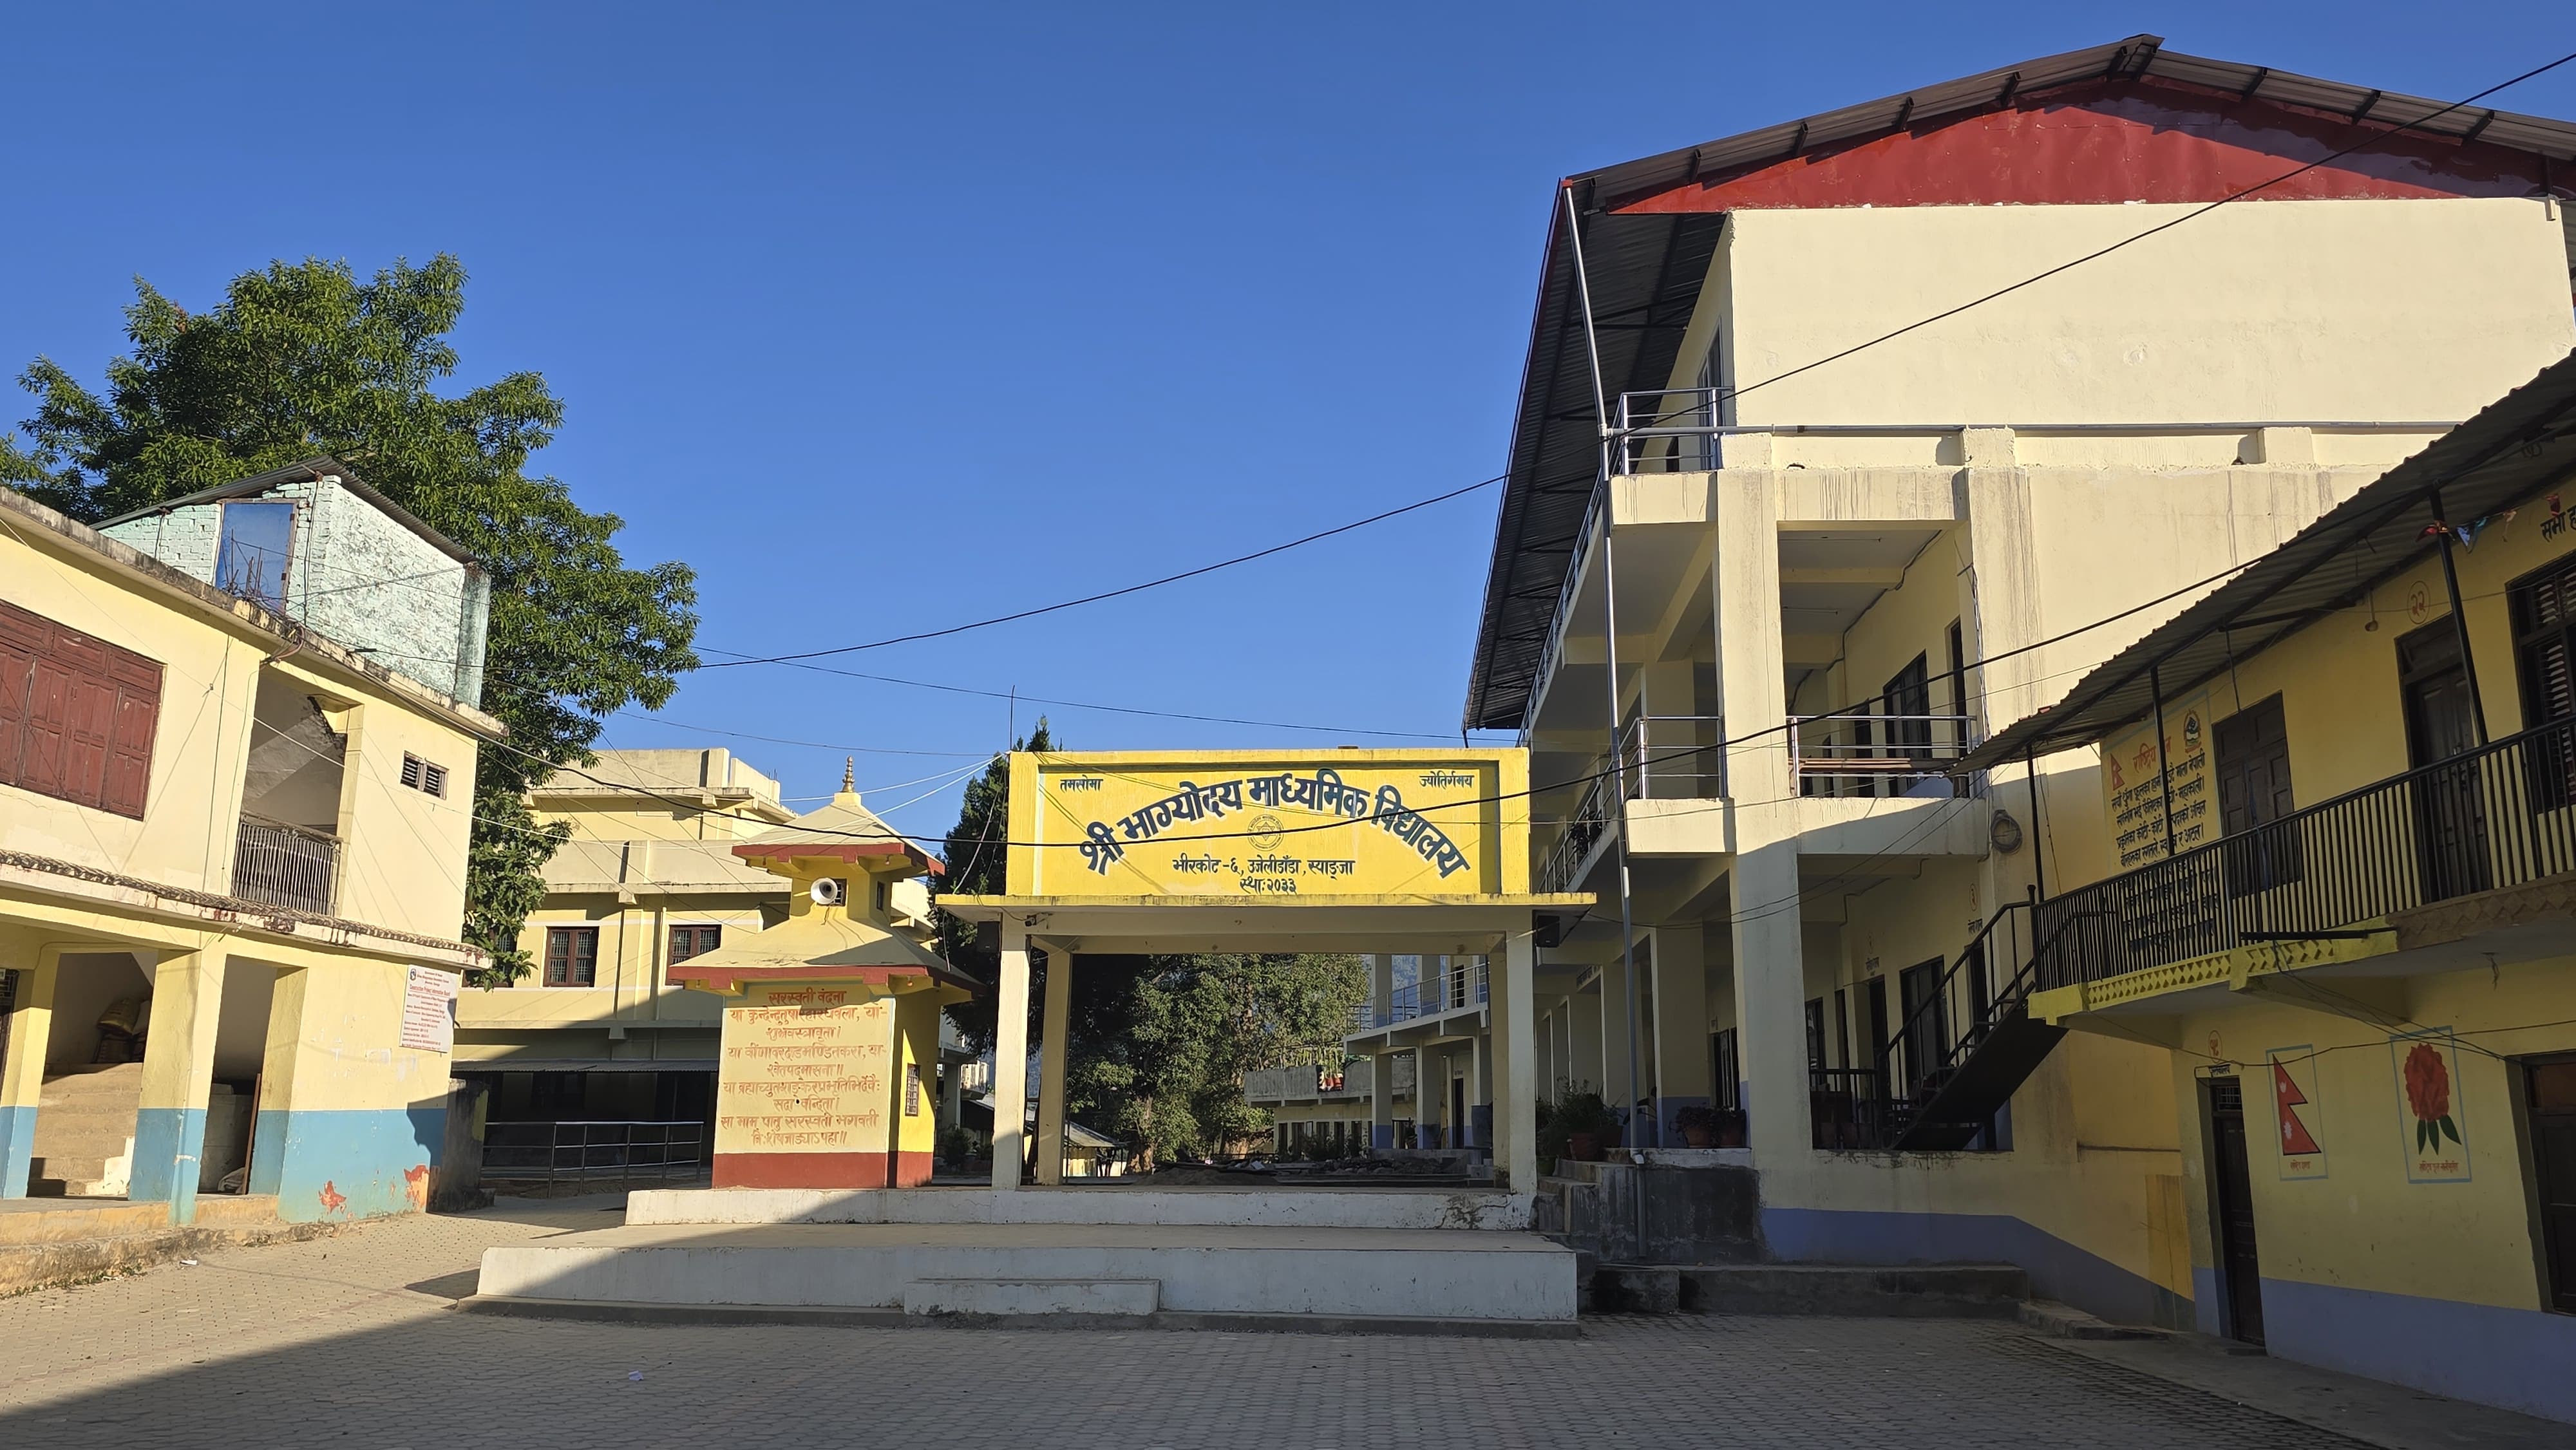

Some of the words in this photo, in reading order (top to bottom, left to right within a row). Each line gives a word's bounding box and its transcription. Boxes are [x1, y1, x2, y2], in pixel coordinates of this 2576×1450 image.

[1060, 774, 1104, 792] तमसोमा
[1419, 770, 1474, 790] ज्योतिर्गमय
[1079, 820, 1124, 876] श्री
[1117, 780, 1243, 840] भाग्योदय
[1247, 767, 1370, 818] माध्यमिक
[1371, 784, 1471, 879] विद्यालय
[768, 986, 816, 1006] सरस्वती
[730, 1009, 744, 1022] या
[728, 1047, 742, 1060] या
[723, 1082, 737, 1095] या
